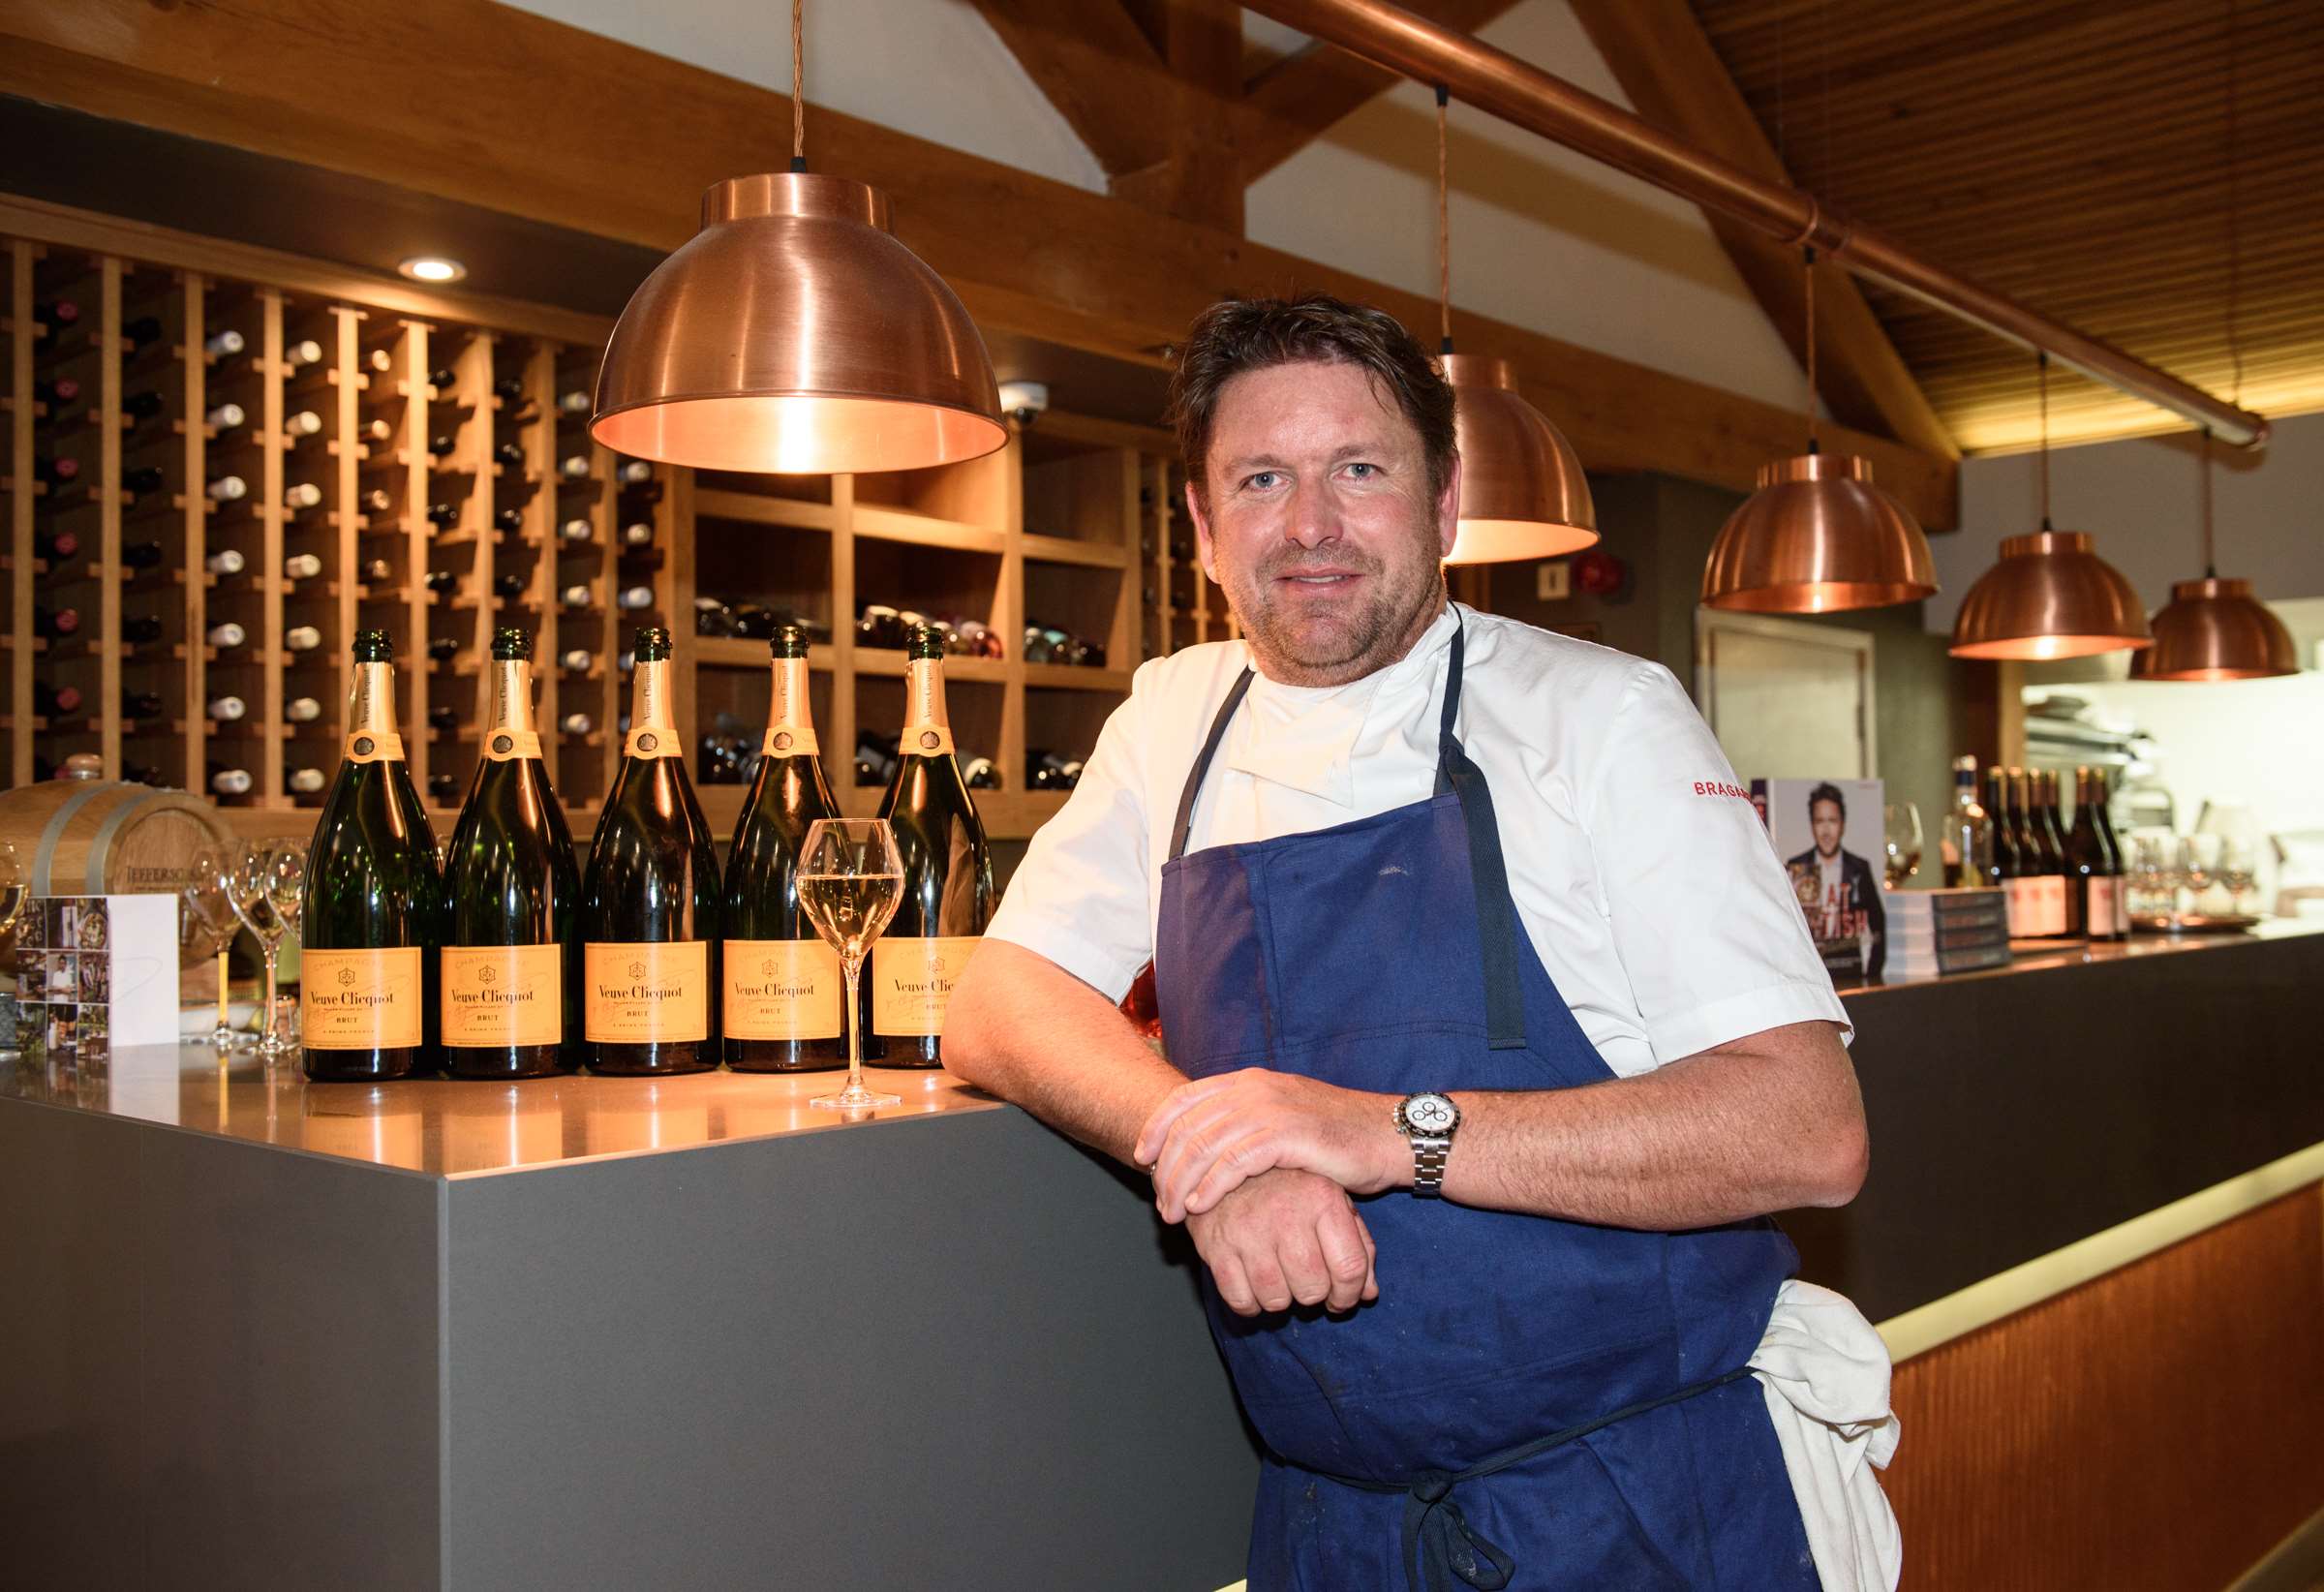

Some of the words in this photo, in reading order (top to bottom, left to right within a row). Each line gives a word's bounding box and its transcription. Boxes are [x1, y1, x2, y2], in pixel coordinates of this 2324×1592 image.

[599, 984, 628, 999] Veuve
[631, 985, 682, 1000] Clicquot
[735, 982, 762, 996] Veuve
[764, 982, 813, 998] Clicquot
[894, 978, 927, 993] Veuve
[931, 978, 954, 993] Clic
[311, 991, 338, 1005] Veuve
[341, 991, 393, 1007] Clicquot
[451, 989, 478, 1003] Veuve
[481, 989, 534, 1004] Clicquot
